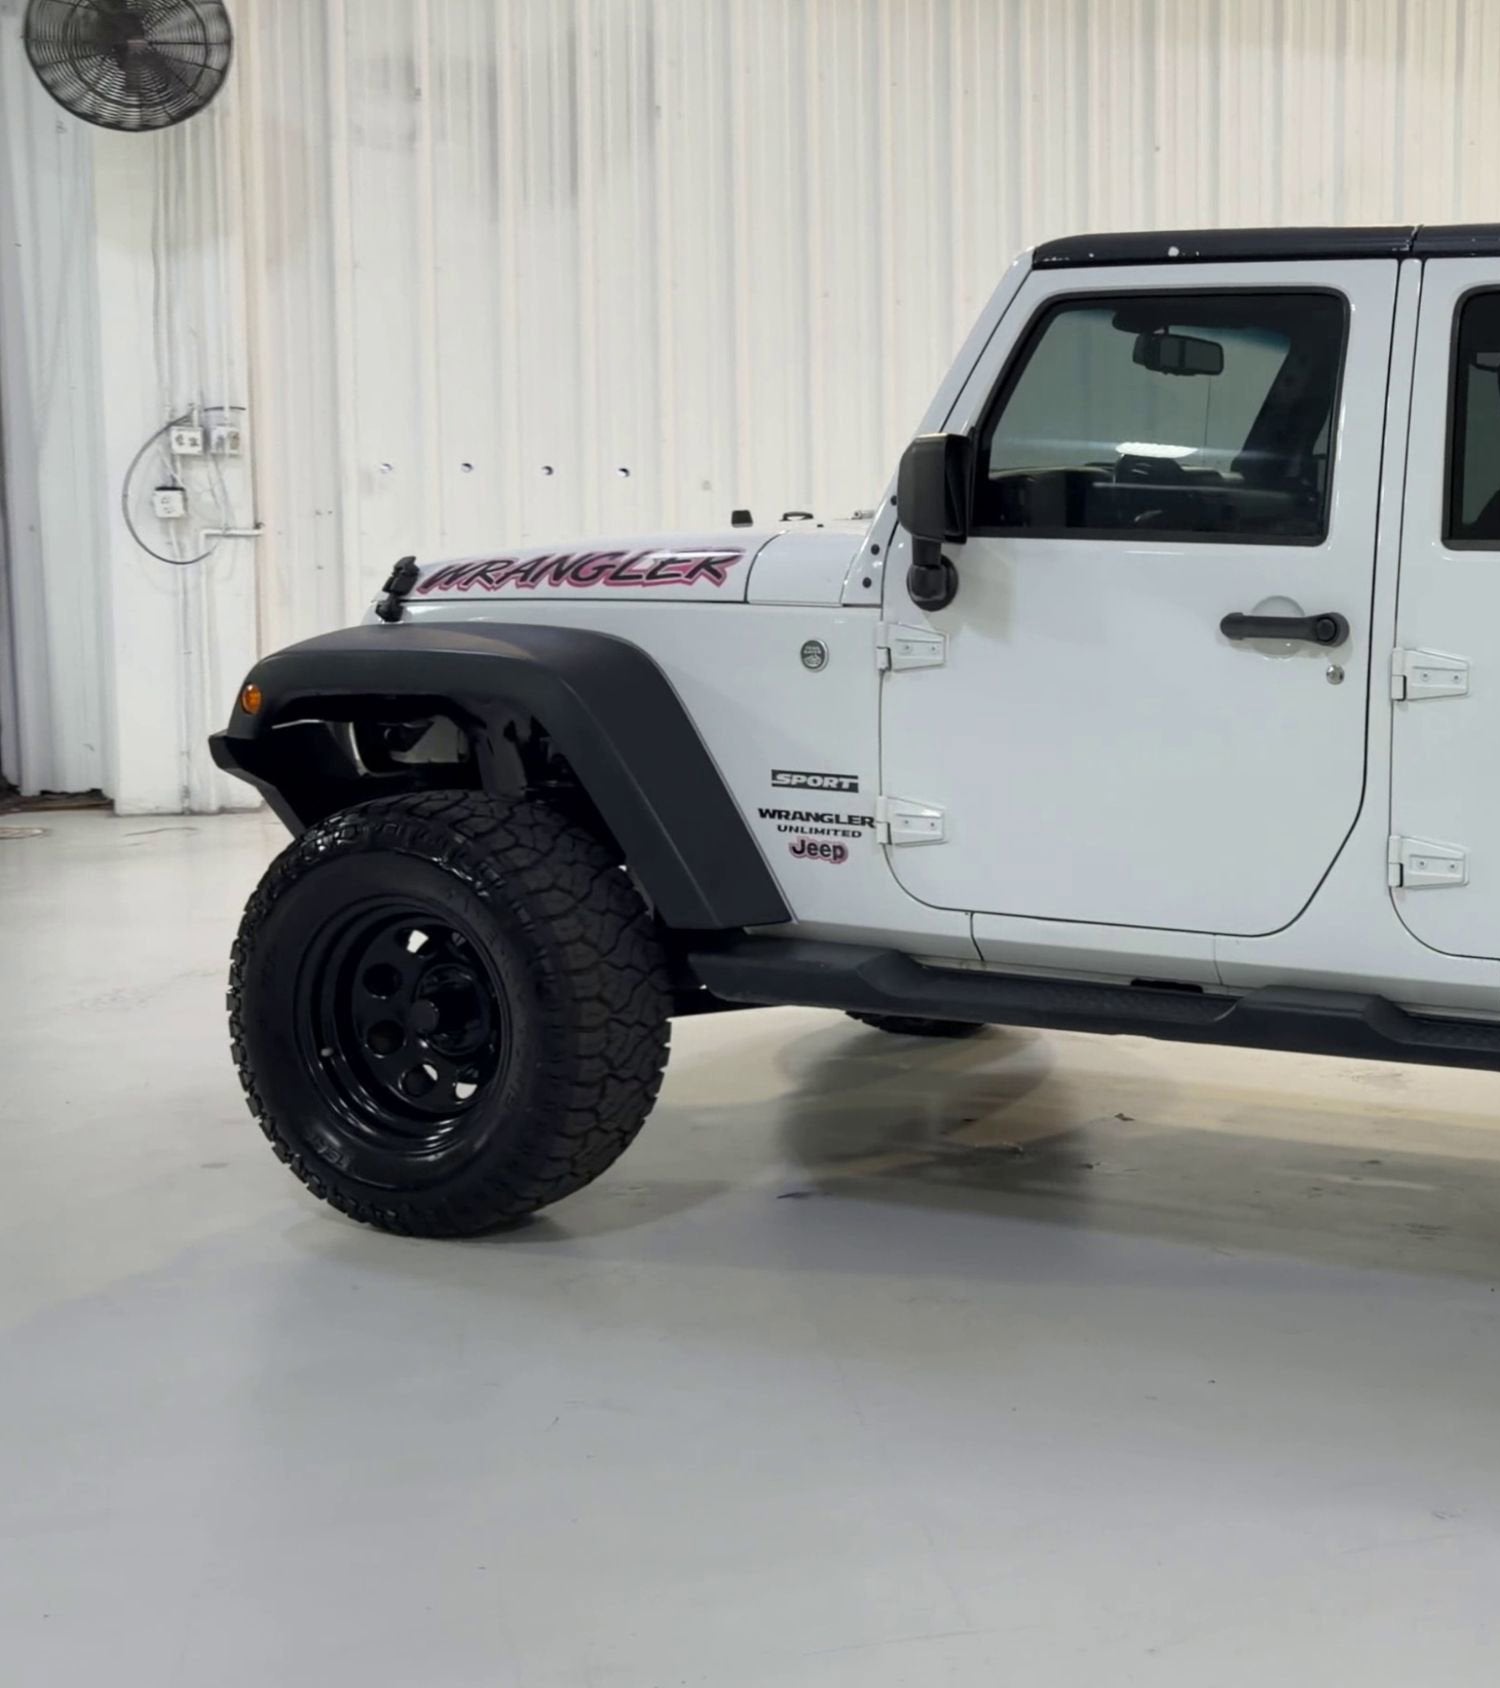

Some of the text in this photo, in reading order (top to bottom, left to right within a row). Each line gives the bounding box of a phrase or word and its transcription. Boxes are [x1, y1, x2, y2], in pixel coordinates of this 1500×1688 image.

[416, 549, 746, 595] WRANGLER
[775, 772, 857, 790] SPORT
[758, 808, 876, 829] WRANGLER
[777, 824, 862, 838] UNLIMITED
[789, 837, 847, 863] Jeep
